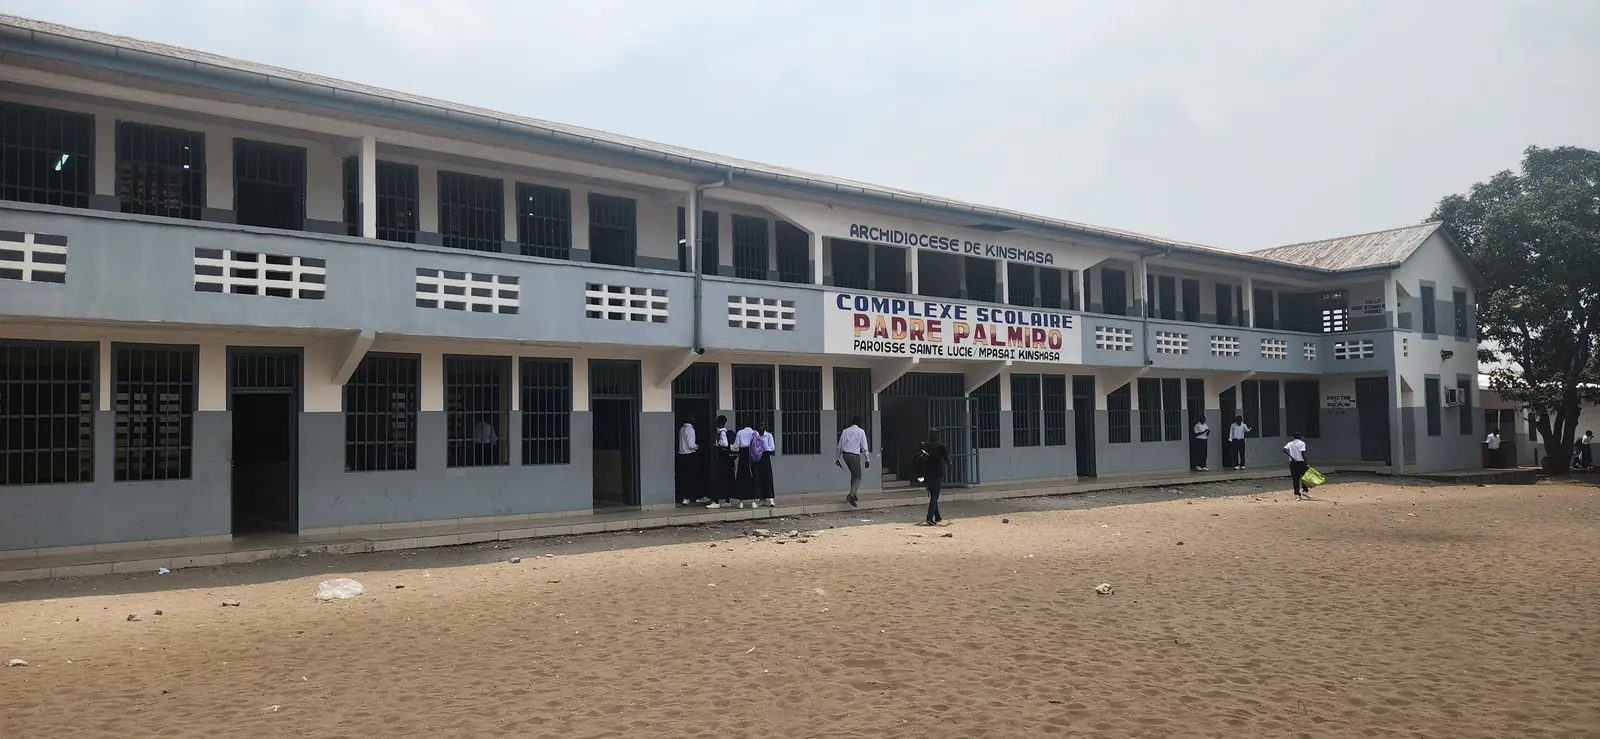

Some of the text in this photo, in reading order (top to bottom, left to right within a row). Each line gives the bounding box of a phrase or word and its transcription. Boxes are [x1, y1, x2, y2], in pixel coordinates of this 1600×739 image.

[850, 223, 1054, 265] ARCHIDIOCESE DE KINSHASA
[836, 293, 1073, 329] COMPLEXE SCOLAIRE
[853, 313, 1063, 350] PADRE PALMIRO
[853, 339, 906, 353] PAROISSE
[909, 343, 943, 356] SAINTE
[1018, 349, 1060, 361] KINSHASA
